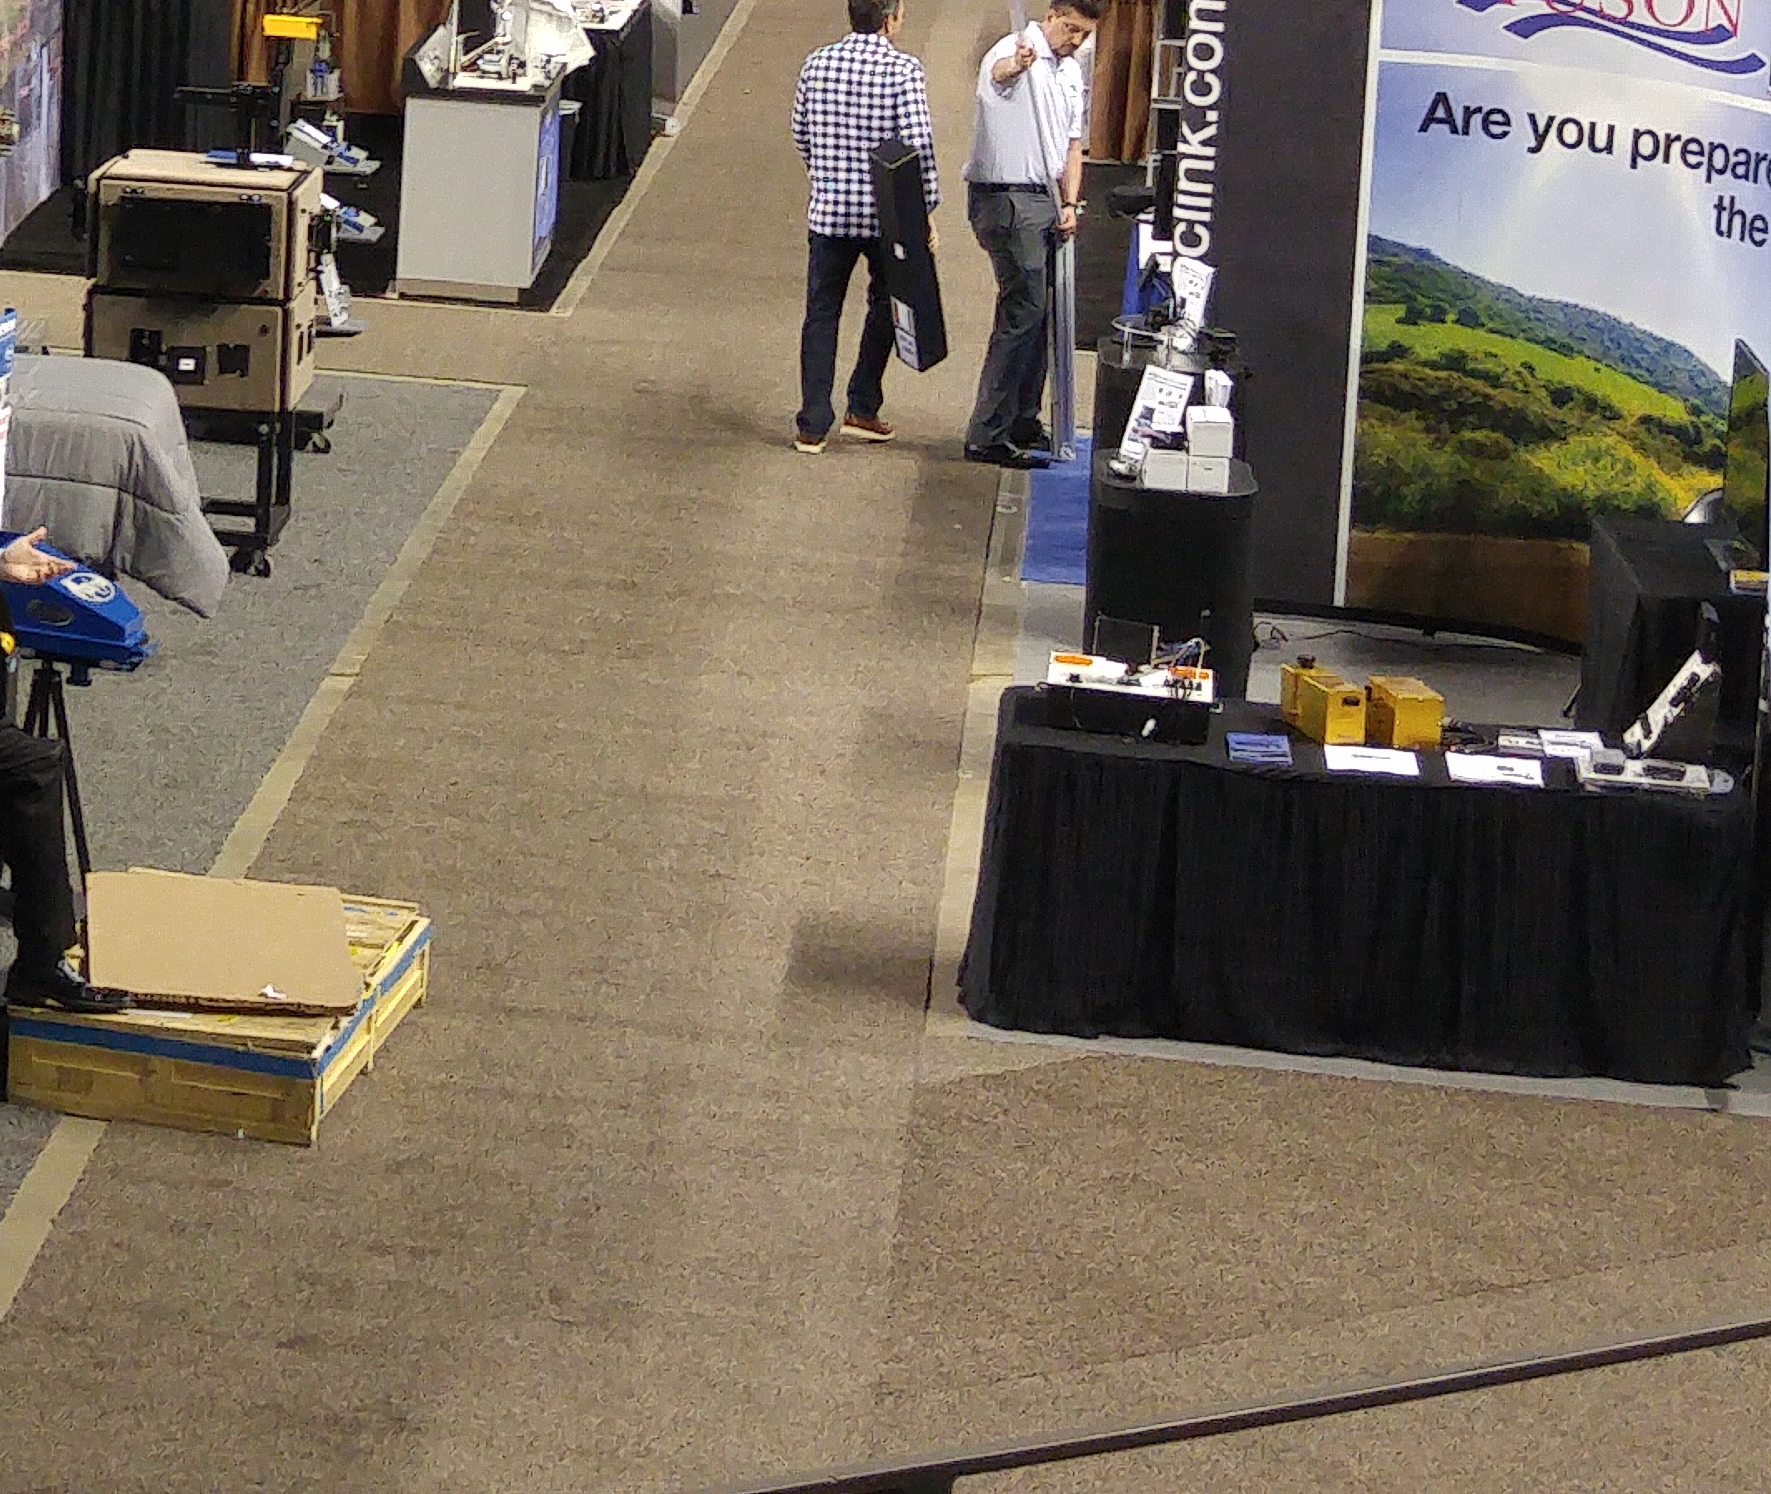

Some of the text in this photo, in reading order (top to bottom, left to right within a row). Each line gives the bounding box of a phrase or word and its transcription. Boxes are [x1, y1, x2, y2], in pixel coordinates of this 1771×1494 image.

[1418, 91, 1513, 140] Are
[1526, 107, 1616, 156] you
[1712, 194, 1769, 248] the
